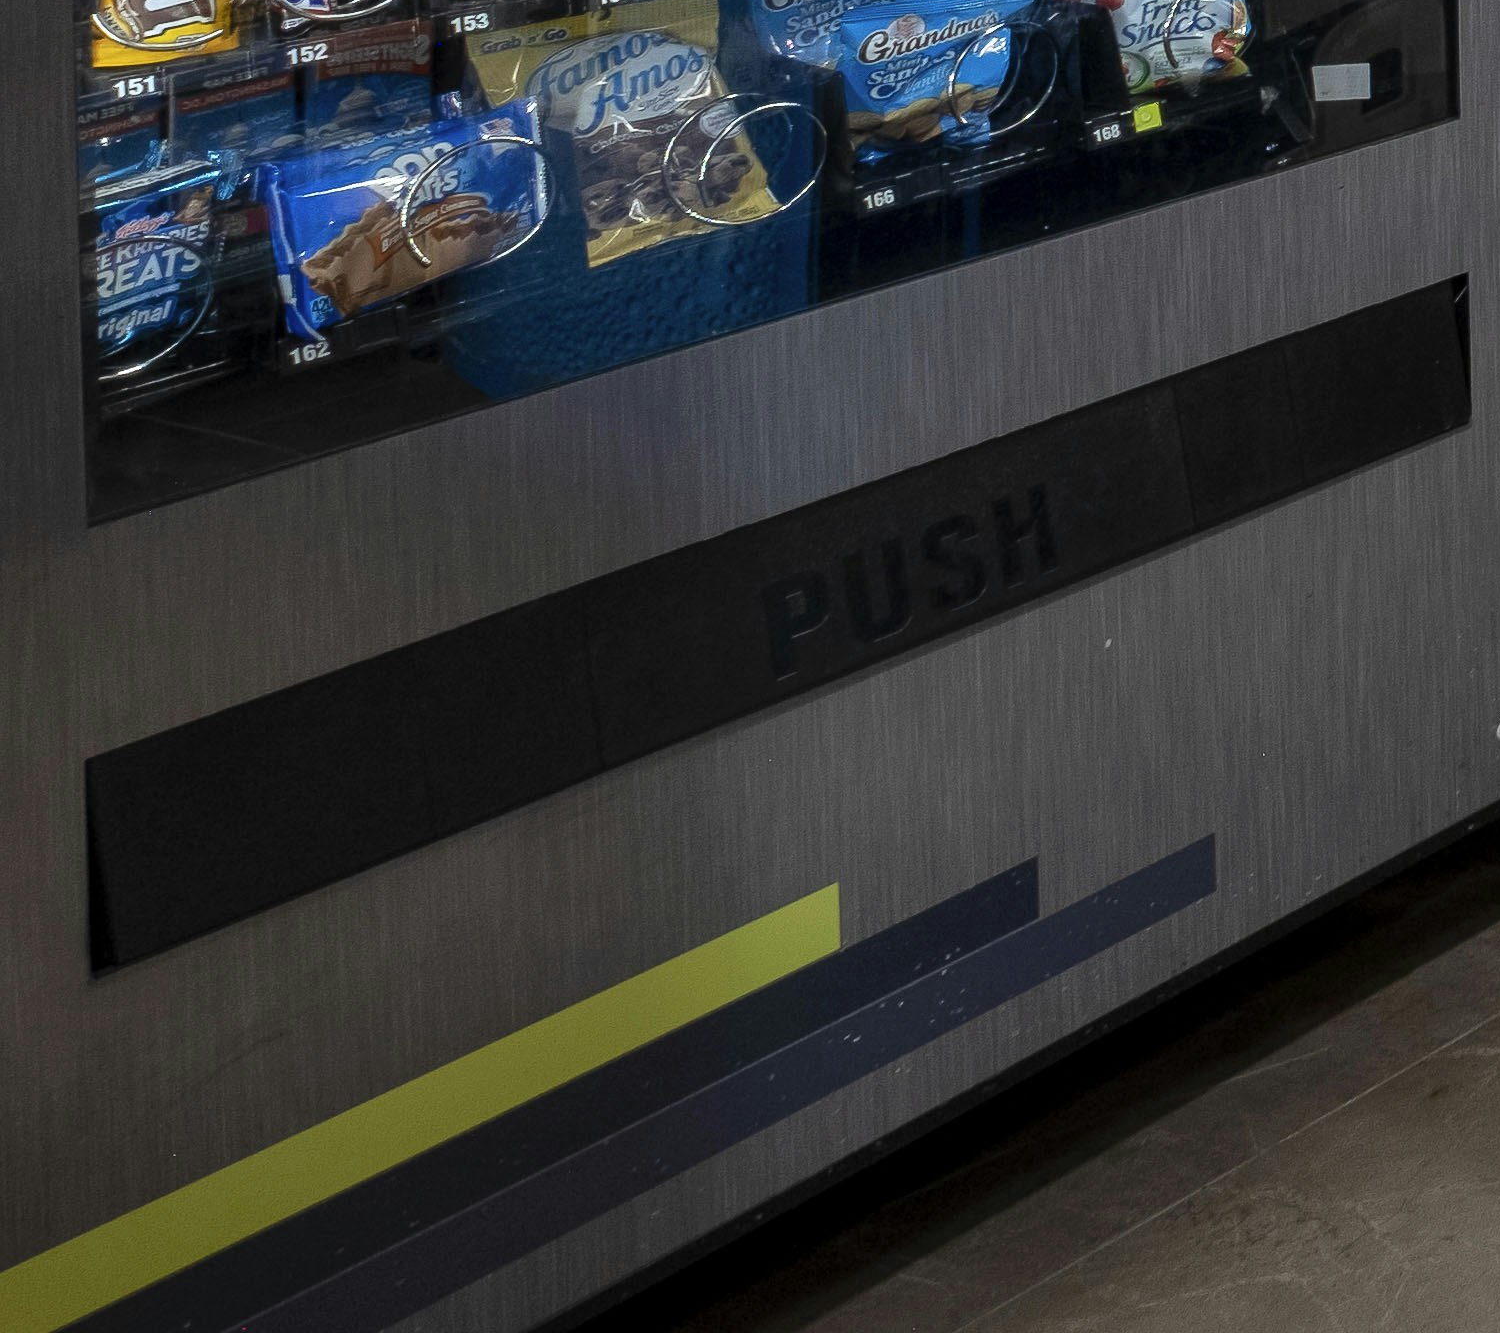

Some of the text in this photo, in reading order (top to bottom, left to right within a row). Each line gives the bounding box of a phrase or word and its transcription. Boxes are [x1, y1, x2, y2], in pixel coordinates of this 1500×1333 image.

[450, 14, 490, 34] 153
[286, 43, 329, 65] 152
[111, 75, 157, 99] 151
[575, 46, 711, 135] Amos
[1093, 123, 1121, 142] 168
[863, 188, 896, 209] 166
[289, 341, 331, 364] 162
[760, 479, 1060, 681] PUSH
